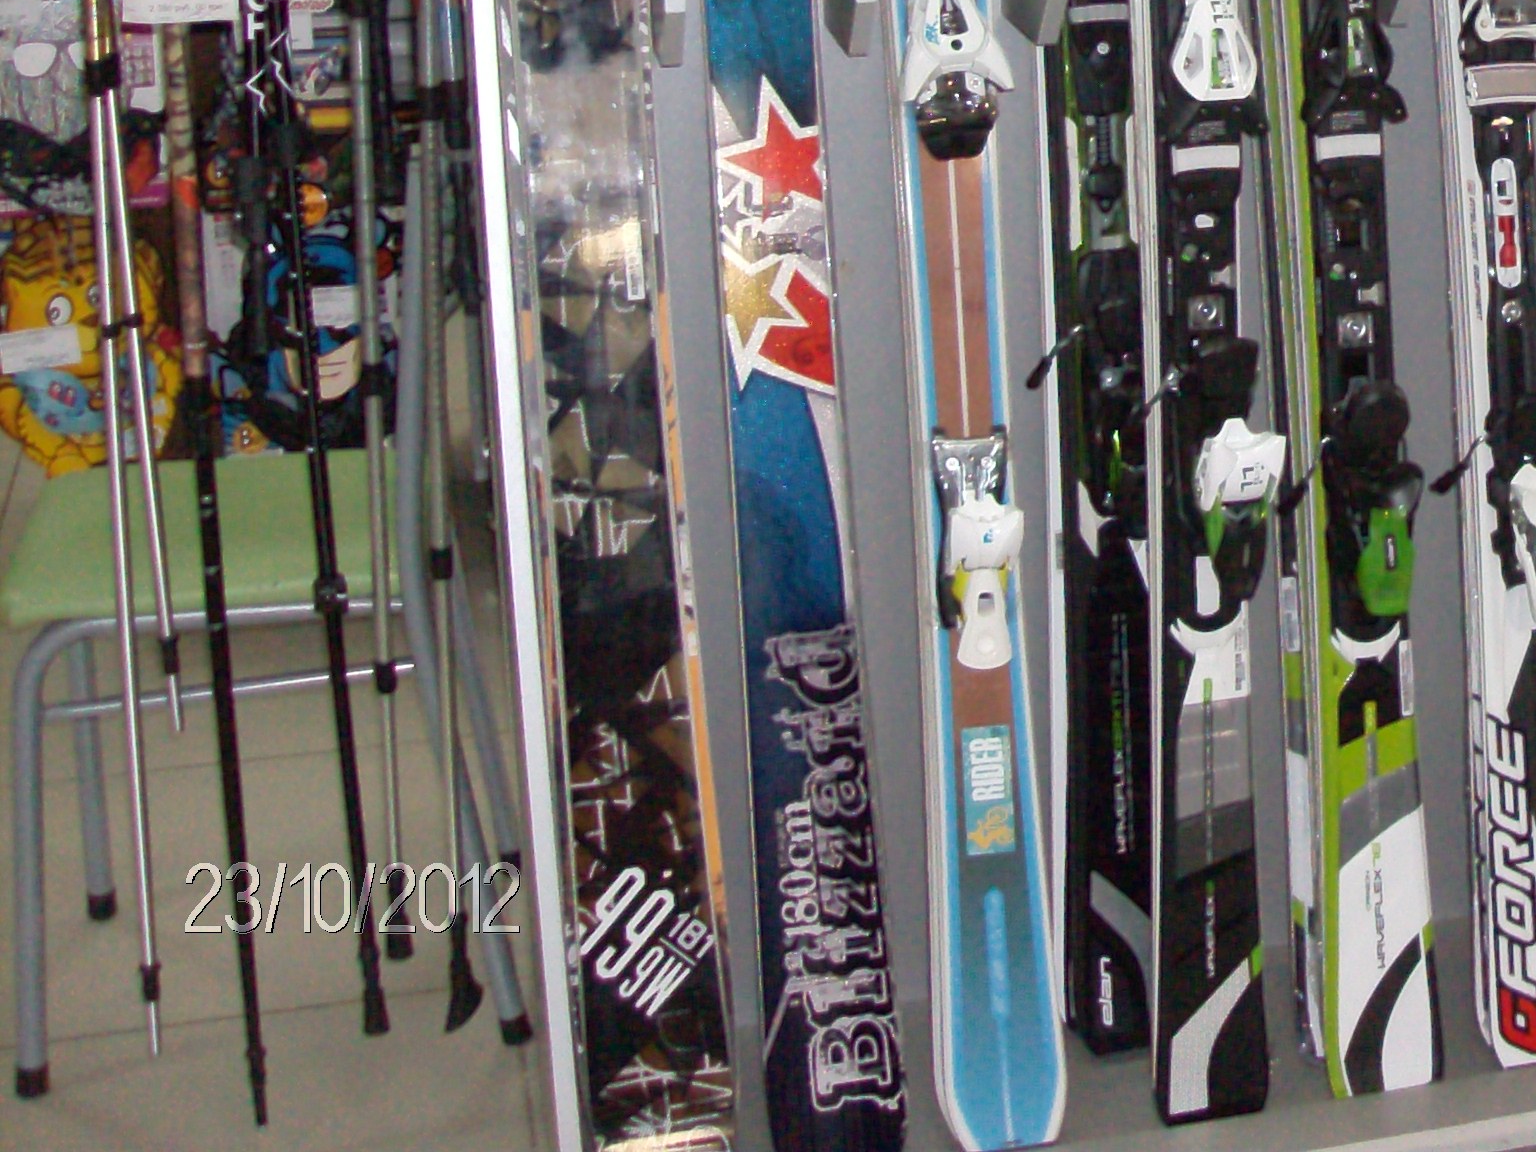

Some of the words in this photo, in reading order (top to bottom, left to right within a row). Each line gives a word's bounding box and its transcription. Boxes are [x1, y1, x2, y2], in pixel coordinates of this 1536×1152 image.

[968, 735, 1005, 802] RIDER
[780, 800, 818, 943] 180cm
[669, 913, 717, 958] 181
[1372, 867, 1386, 970] WAVEFLEX
[1098, 954, 1114, 1027] elan
